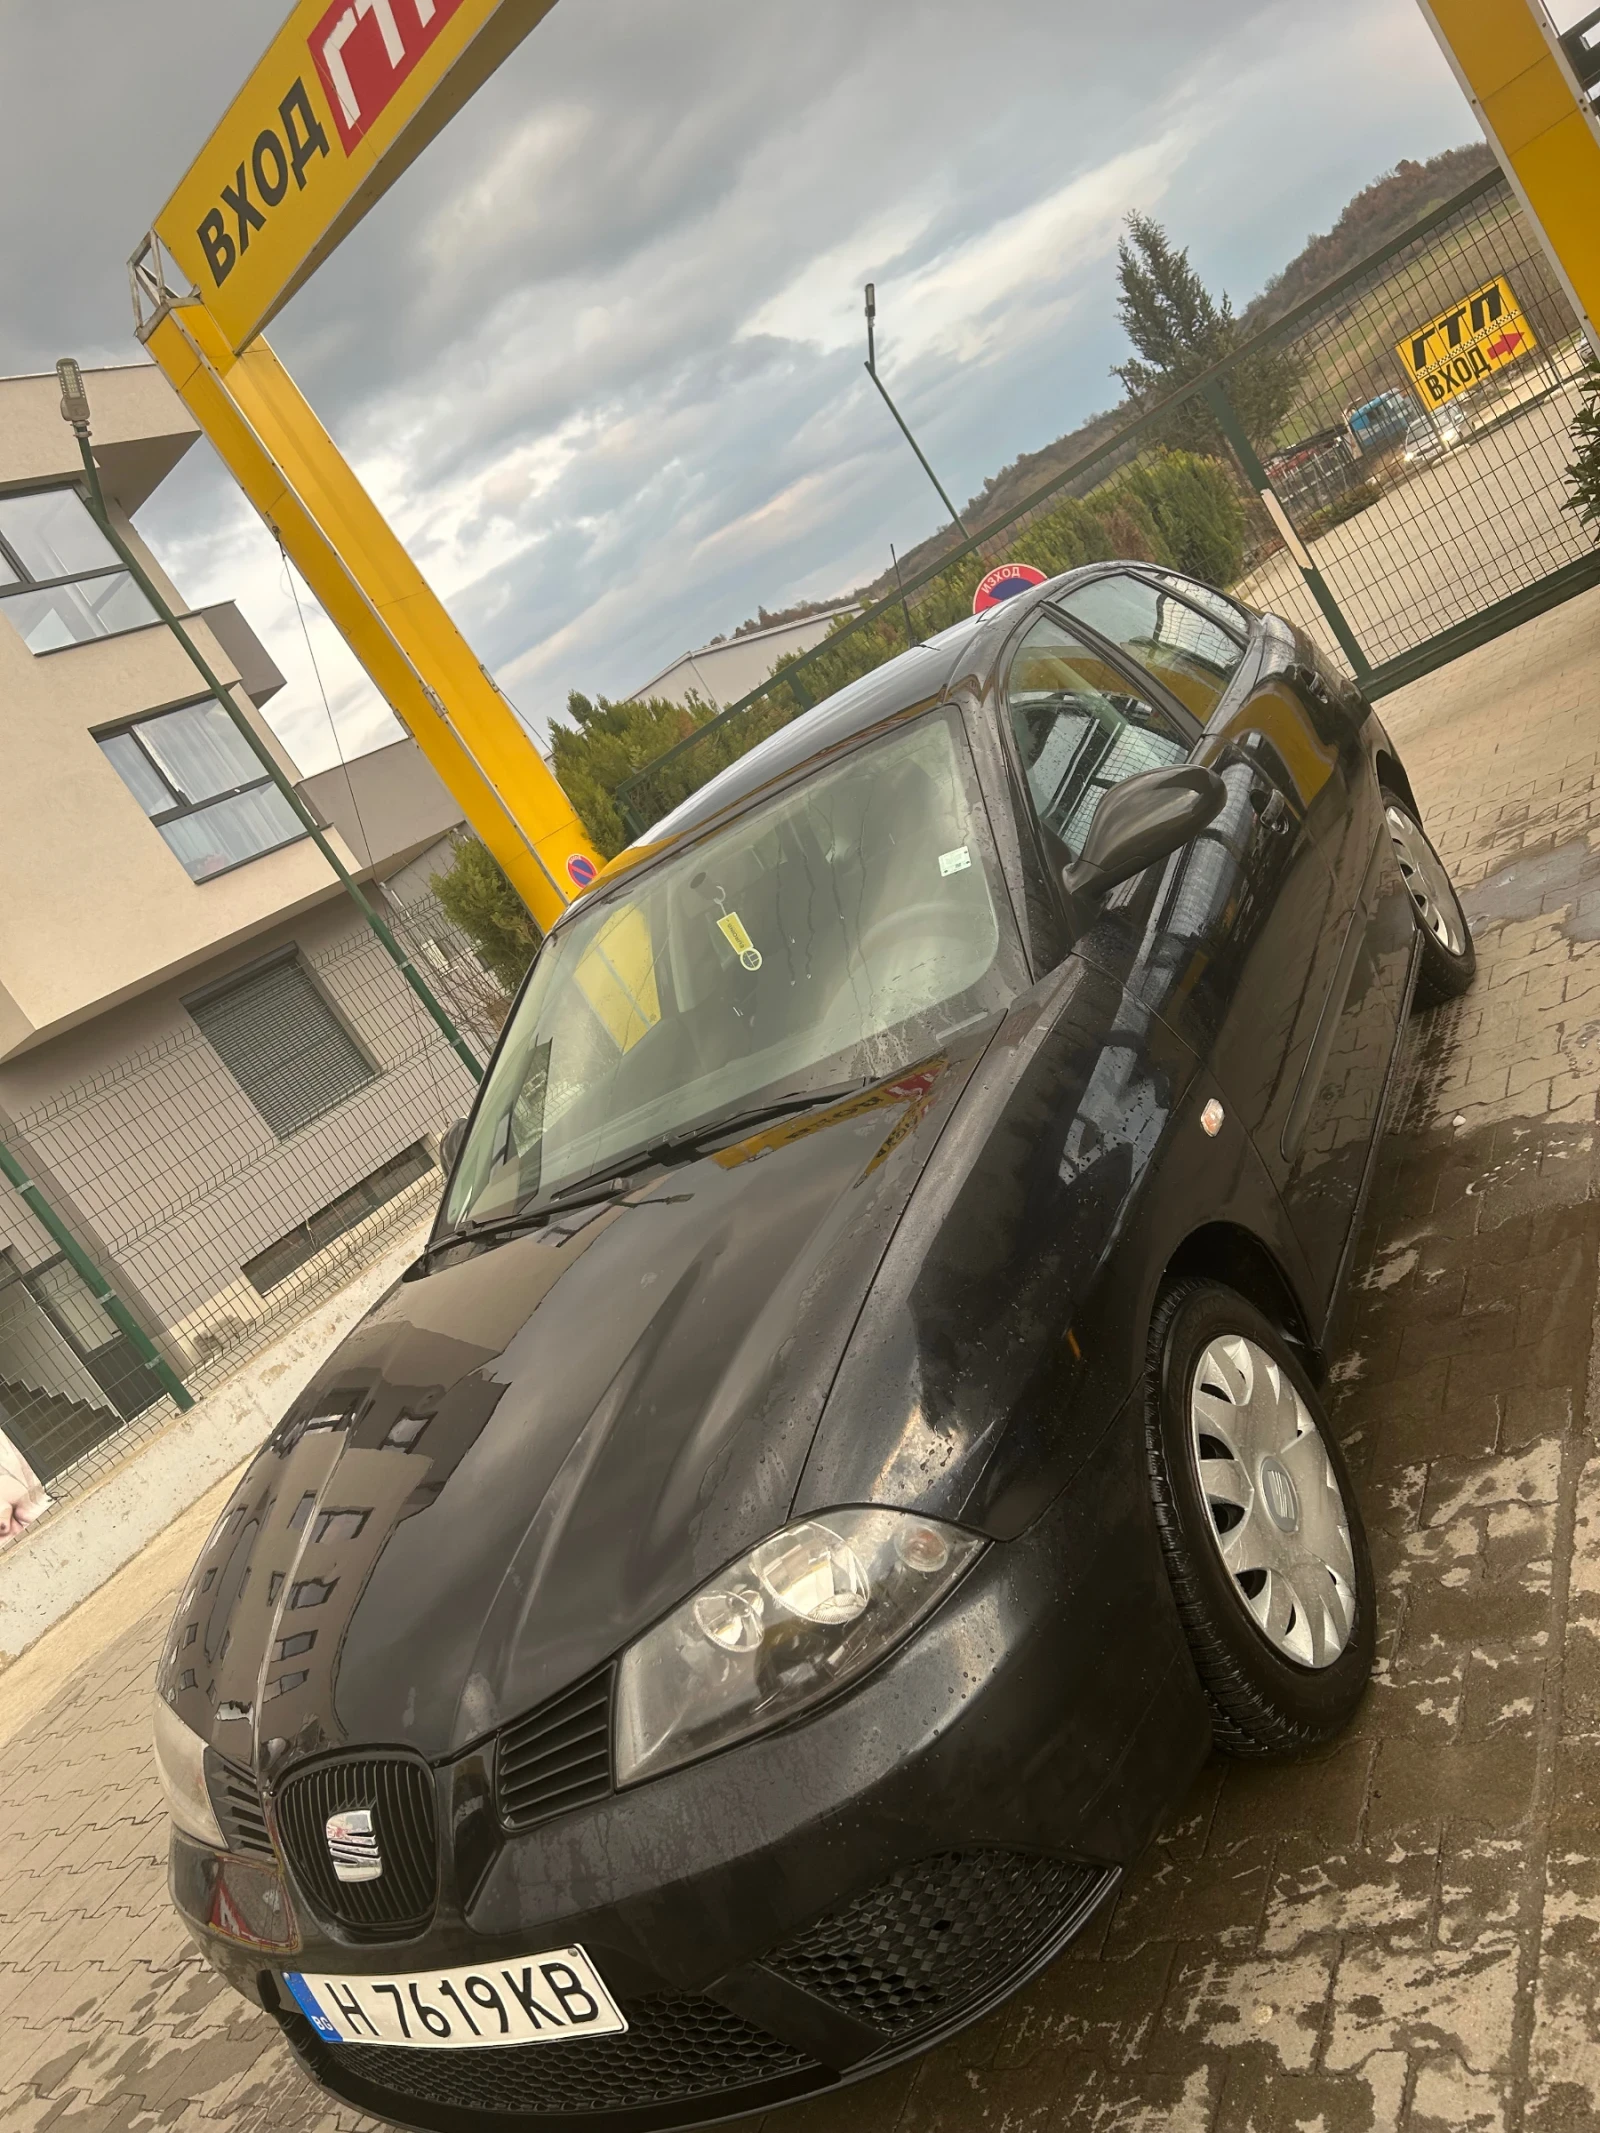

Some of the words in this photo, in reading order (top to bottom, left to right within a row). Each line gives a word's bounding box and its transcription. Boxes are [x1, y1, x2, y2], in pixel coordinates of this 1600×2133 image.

[196, 76, 330, 289] ВХОД
[322, 0, 436, 130] ГТ
[1412, 284, 1502, 372] ГТП
[1424, 345, 1492, 402] ВХОД
[981, 567, 1020, 594] ИЗХОД
[311, 2015, 333, 2031] BG
